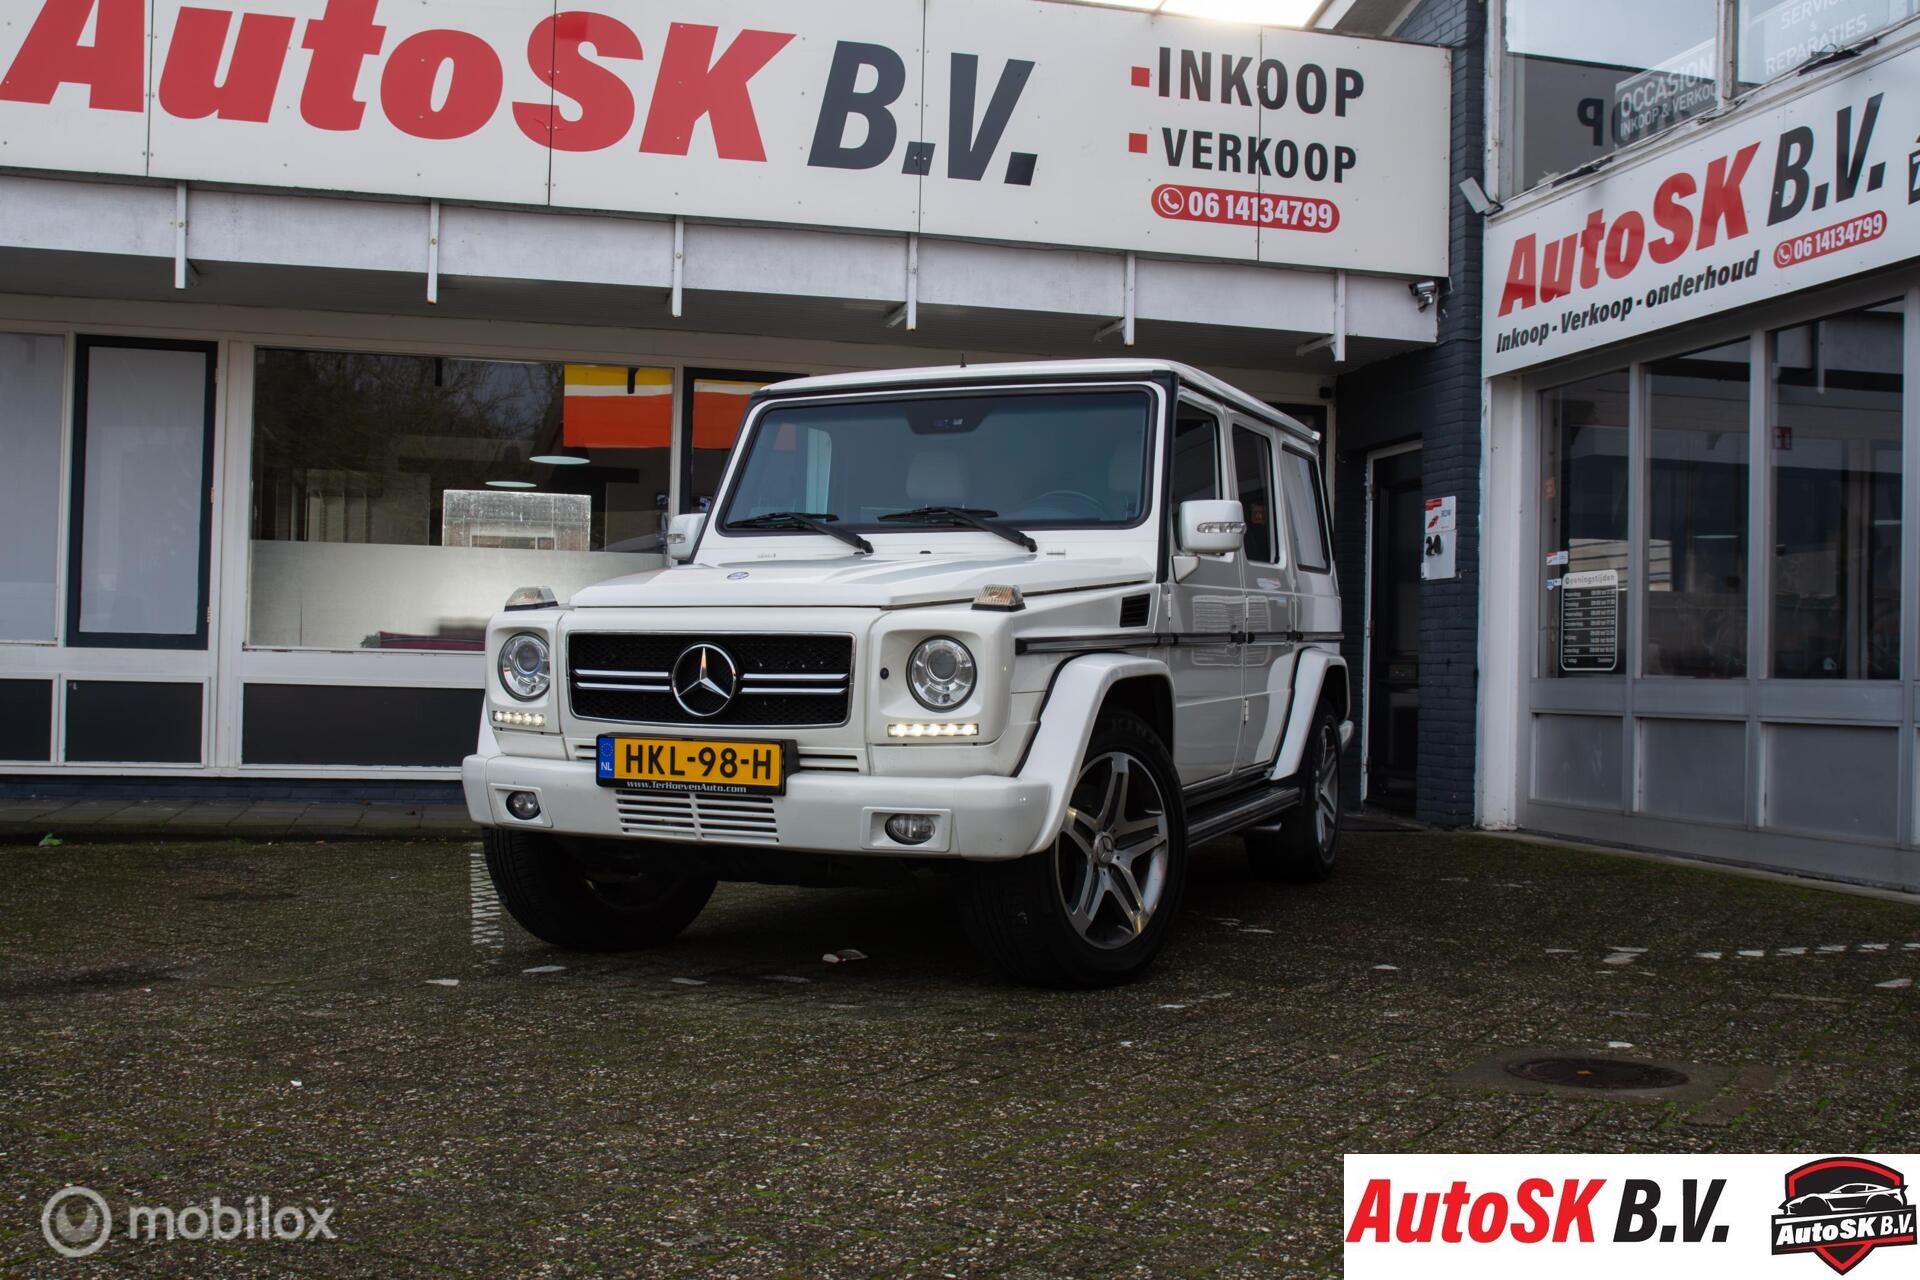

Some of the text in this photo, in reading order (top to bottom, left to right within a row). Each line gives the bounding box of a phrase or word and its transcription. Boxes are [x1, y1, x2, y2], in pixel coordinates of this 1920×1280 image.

[1765, 13, 1868, 76] REPARATIES
[0, 0, 1038, 187] AutoSK B.V.
[1158, 46, 1365, 118] INKOOP
[1620, 81, 1717, 137] INKOOP & VERKOO
[1162, 127, 1358, 184] VERKOOP
[1188, 191, 1333, 229] 06 14134799
[1498, 92, 1886, 317] AutoSK B.V.
[1793, 213, 1884, 260] 06 14134799
[1496, 322, 1550, 354] Inkoop
[1561, 296, 1633, 334] Verkoop
[1645, 249, 1760, 308] onderhoud
[600, 761, 613, 771] NL
[625, 743, 771, 780] HKL-98-H
[626, 780, 747, 793] www.TerHoevenAuto.com
